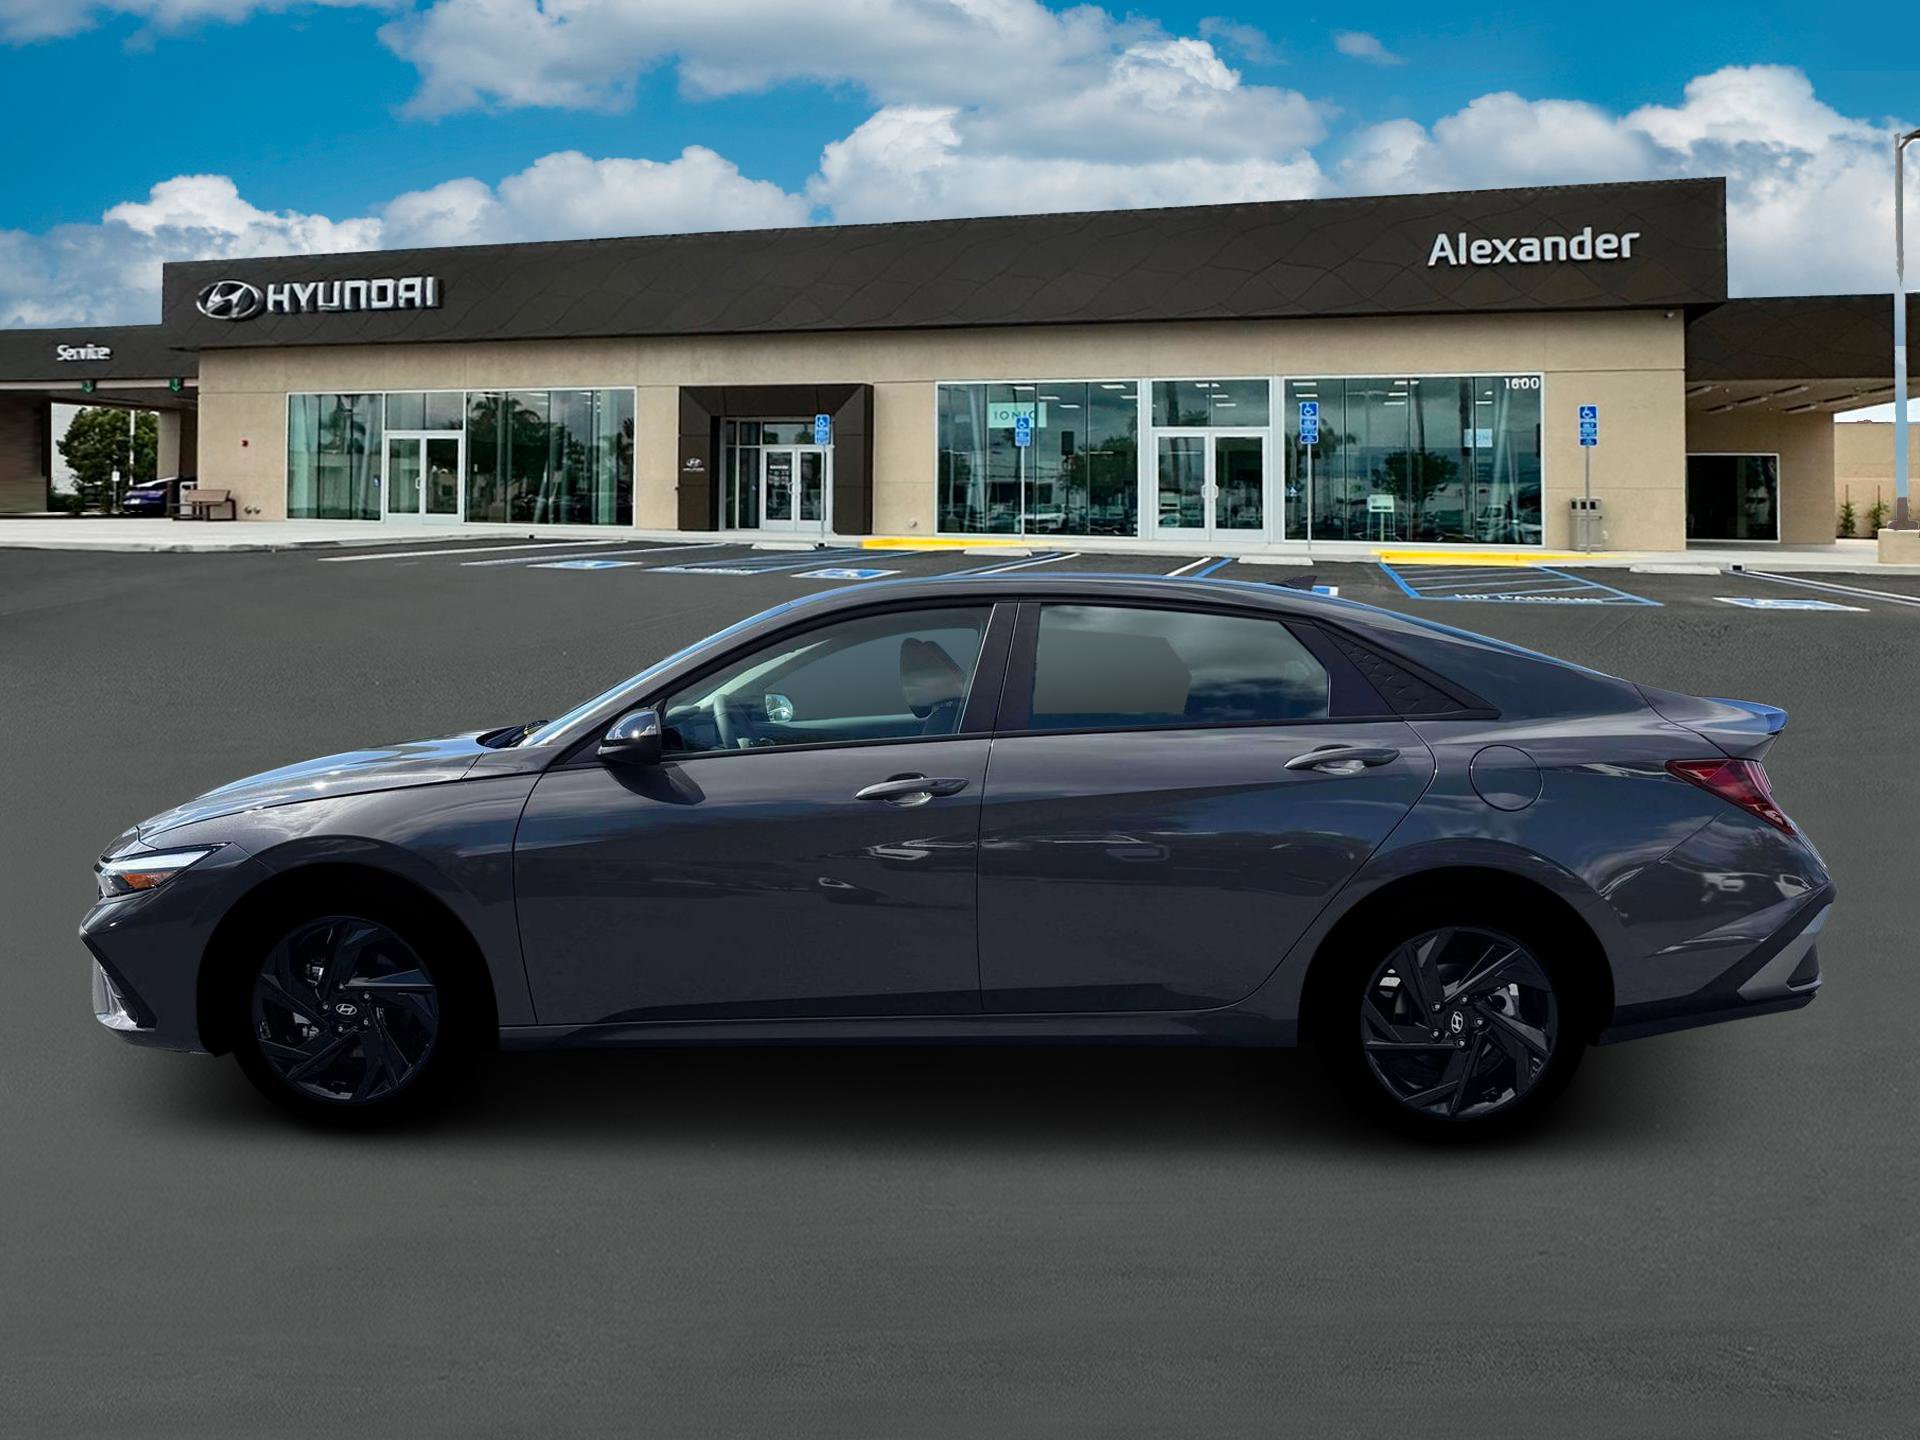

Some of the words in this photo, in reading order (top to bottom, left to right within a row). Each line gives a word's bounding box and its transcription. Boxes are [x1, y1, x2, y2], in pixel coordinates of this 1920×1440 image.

[1427, 226, 1641, 266] Alexander
[266, 276, 438, 313] HYUNDAI
[56, 343, 111, 361] Service
[1504, 377, 1540, 390] 1600
